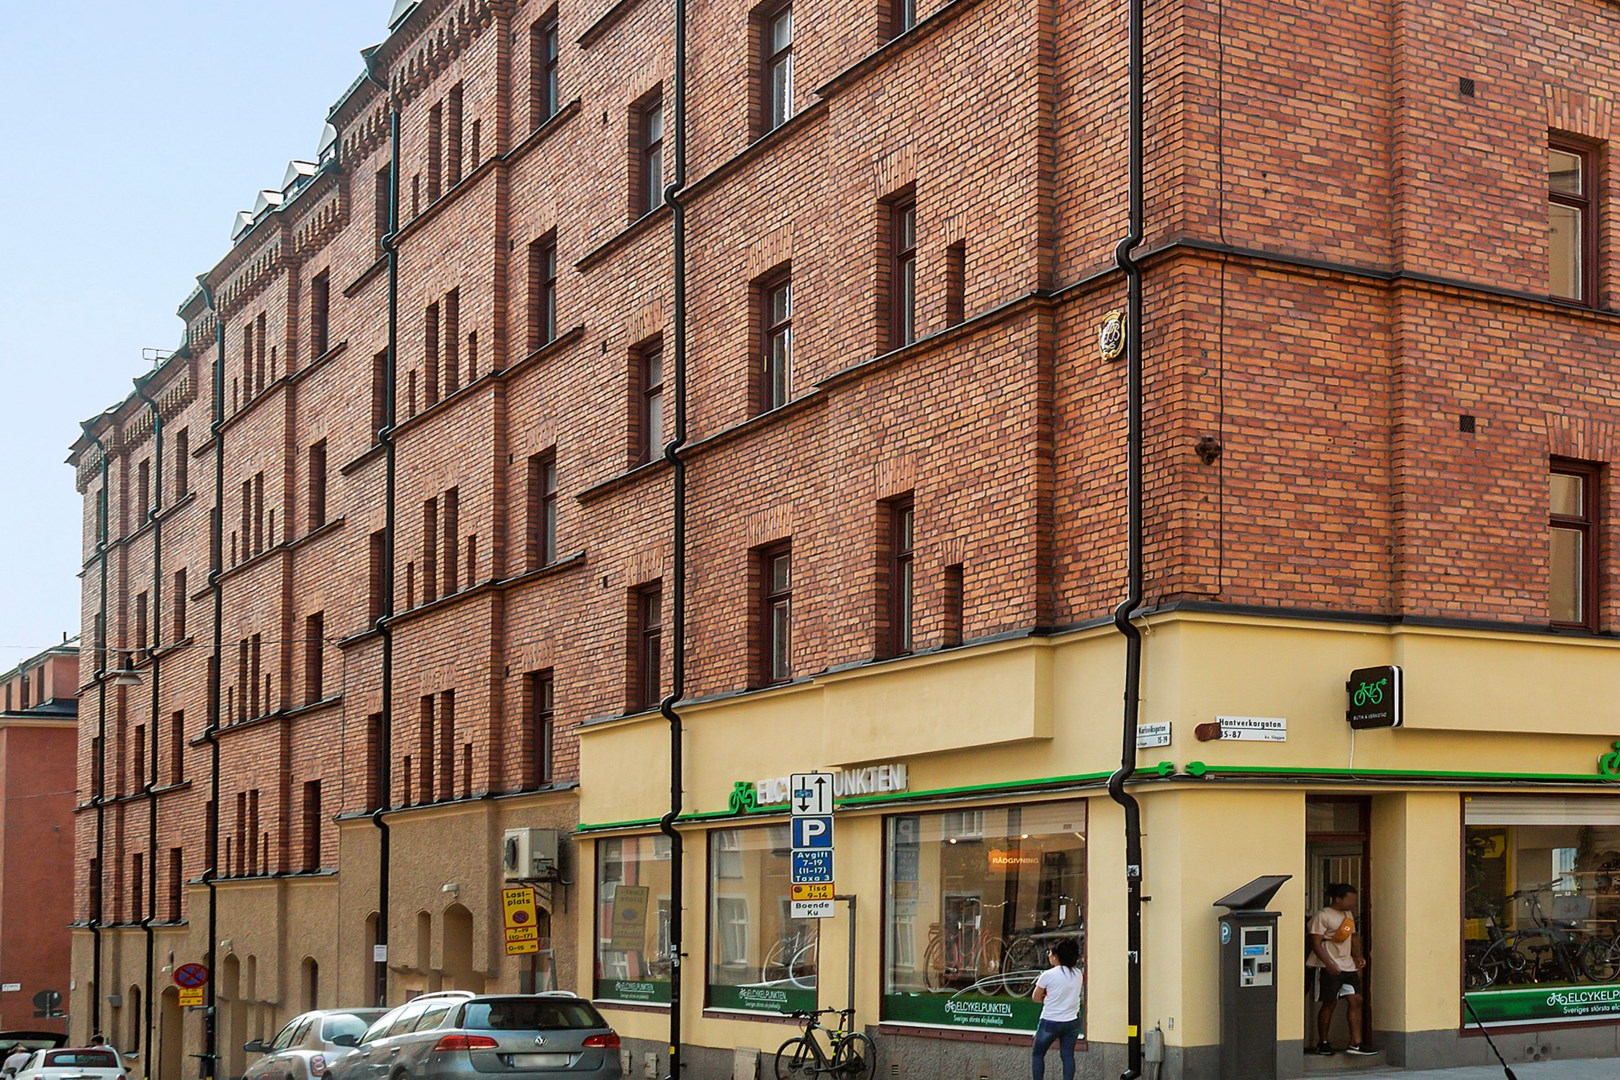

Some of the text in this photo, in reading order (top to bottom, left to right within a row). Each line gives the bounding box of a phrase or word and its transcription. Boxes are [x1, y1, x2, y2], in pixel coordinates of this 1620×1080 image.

[1219, 718, 1282, 730] Hantverkargatan
[802, 819, 826, 847] P
[797, 851, 828, 860] Avgift
[992, 856, 1039, 864] RÅDGIVNING
[507, 898, 531, 906] plats
[1222, 926, 1229, 941] P
[746, 989, 787, 1000] ELCYKELPUNKTEN
[956, 1001, 1011, 1014] ELCYKELPUNKTEN
[1563, 1006, 1589, 1015] Sveriges
[1590, 1005, 1610, 1013] största
